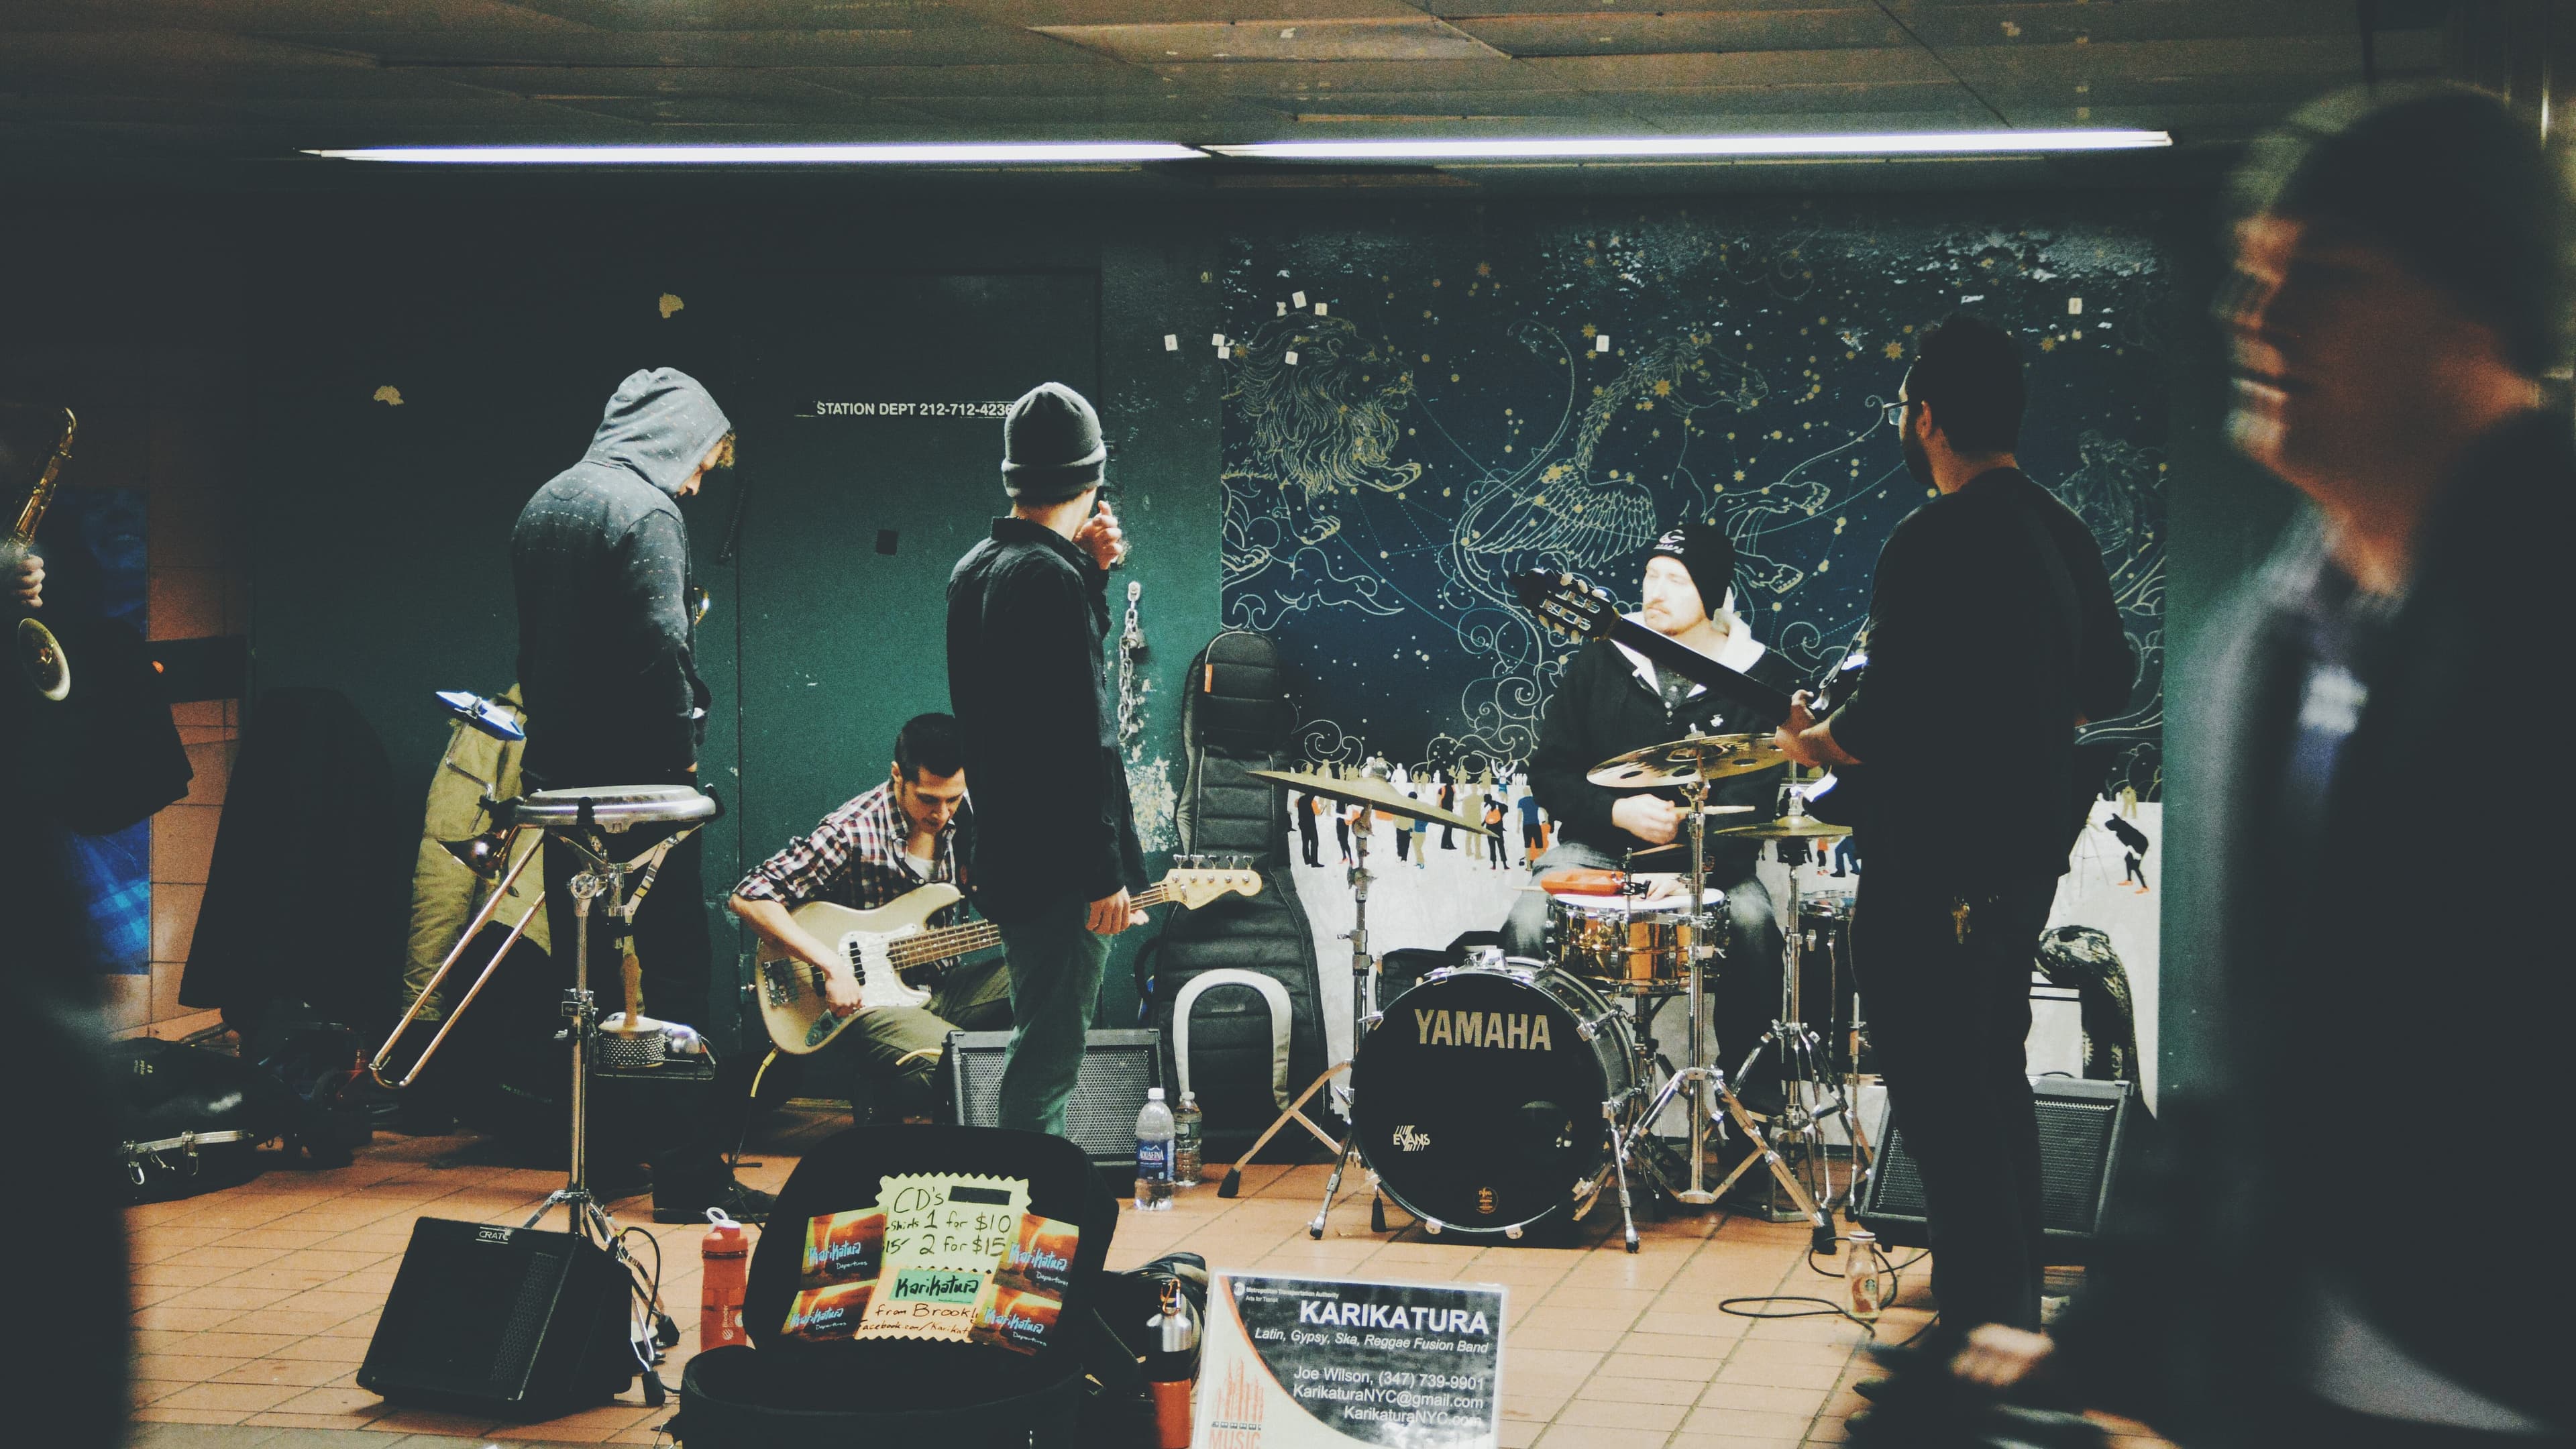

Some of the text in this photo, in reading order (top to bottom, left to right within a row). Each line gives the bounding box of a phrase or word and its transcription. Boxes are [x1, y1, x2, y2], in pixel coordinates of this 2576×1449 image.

[816, 402, 1013, 416] STATION DEPT 212-712-4236
[1414, 1009, 1551, 1051] YAMAHA
[1393, 1127, 1431, 1150] EVANS
[1139, 1148, 1165, 1161] AQUAFINA
[894, 1187, 944, 1214] CD's
[924, 1210, 1011, 1233] 1 for $10
[479, 1231, 508, 1241] CRATE
[919, 1234, 1006, 1256] 2 for $15
[895, 1275, 979, 1298] Karikatura
[1316, 1291, 1340, 1299] Authority
[875, 1304, 907, 1316] from
[1300, 1299, 1489, 1335] KARIKATURA
[1254, 1327, 1489, 1353] Latin, Gypsy, Ska, Reggae Fusion Band
[1293, 1365, 1484, 1391] Joe Wilson, (347) 739-9901
[1293, 1383, 1483, 1409] KarikaturaNYC@gmail.com
[1344, 1405, 1483, 1427] KarikaturaNYC.com
[1208, 1429, 1261, 1449] MUSIC
